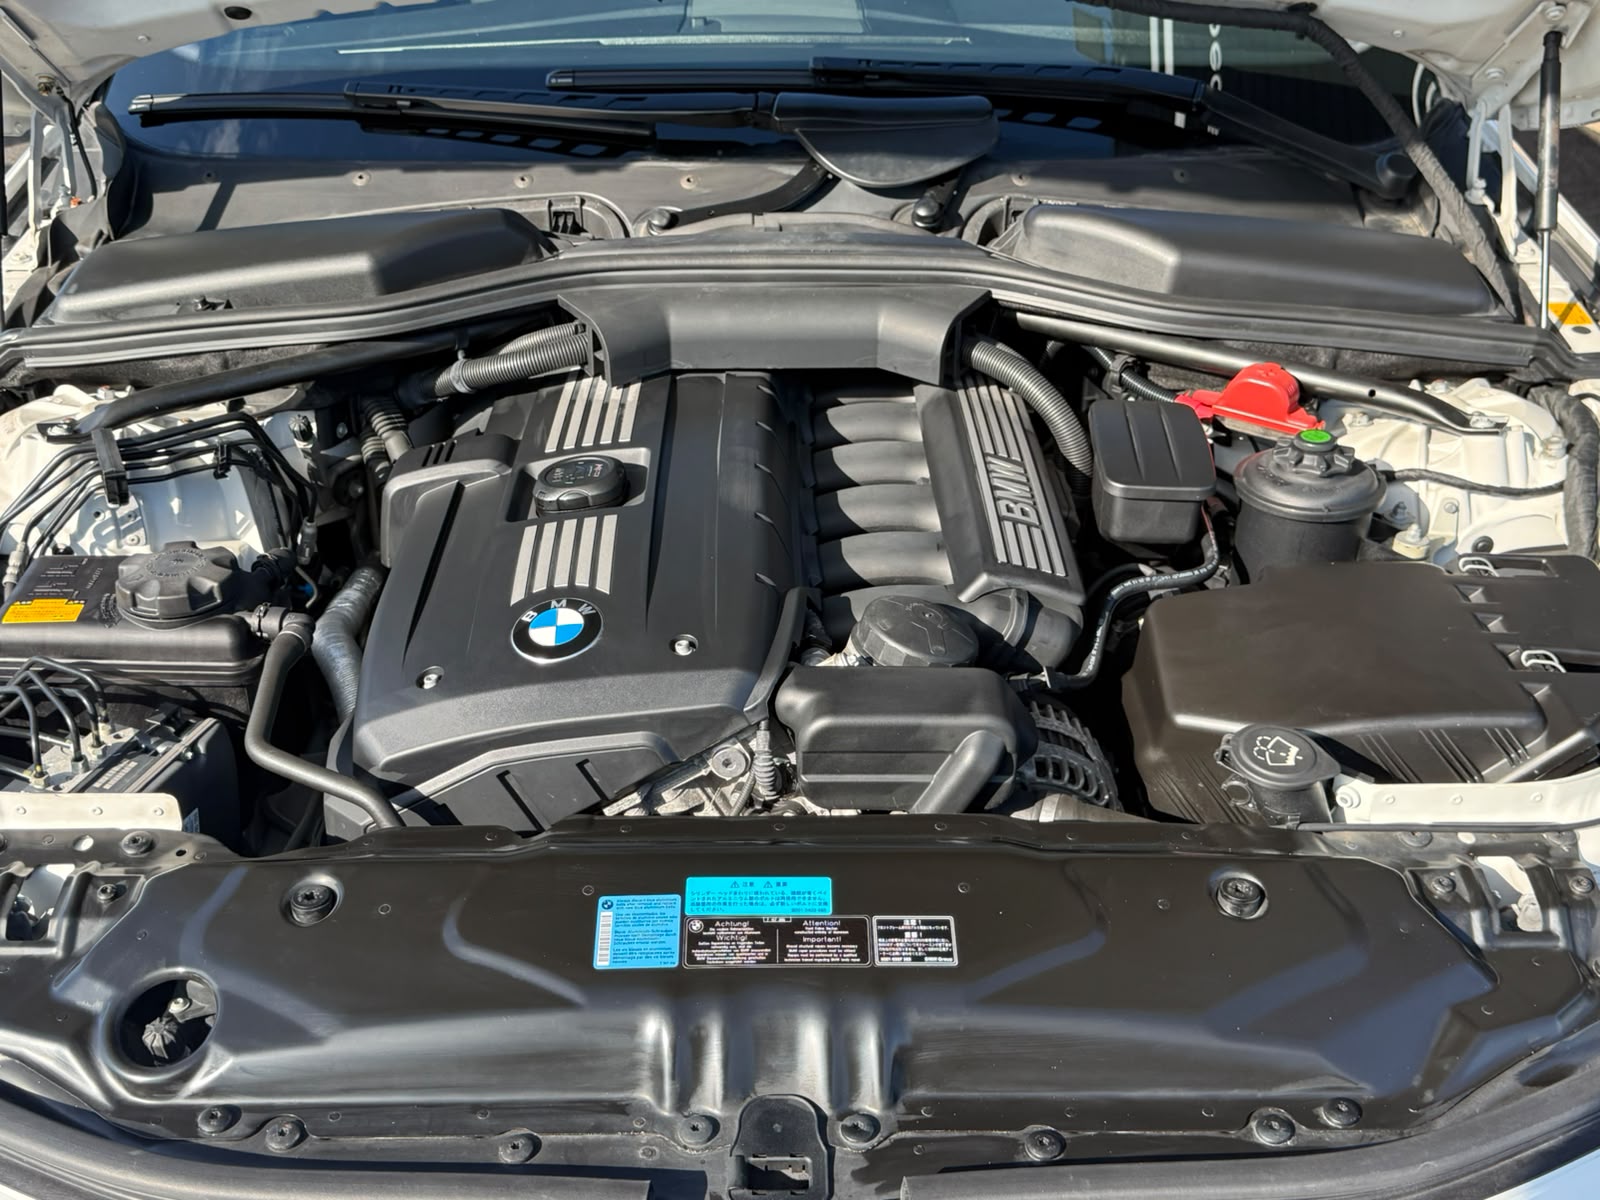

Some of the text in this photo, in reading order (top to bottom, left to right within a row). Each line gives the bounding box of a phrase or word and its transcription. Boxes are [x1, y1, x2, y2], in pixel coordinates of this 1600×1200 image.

[984, 453, 1042, 529] BMW
[521, 599, 597, 623] BMW
[714, 920, 750, 928] Achtung!
[802, 919, 841, 927] Attention!
[802, 935, 842, 943] Important!
